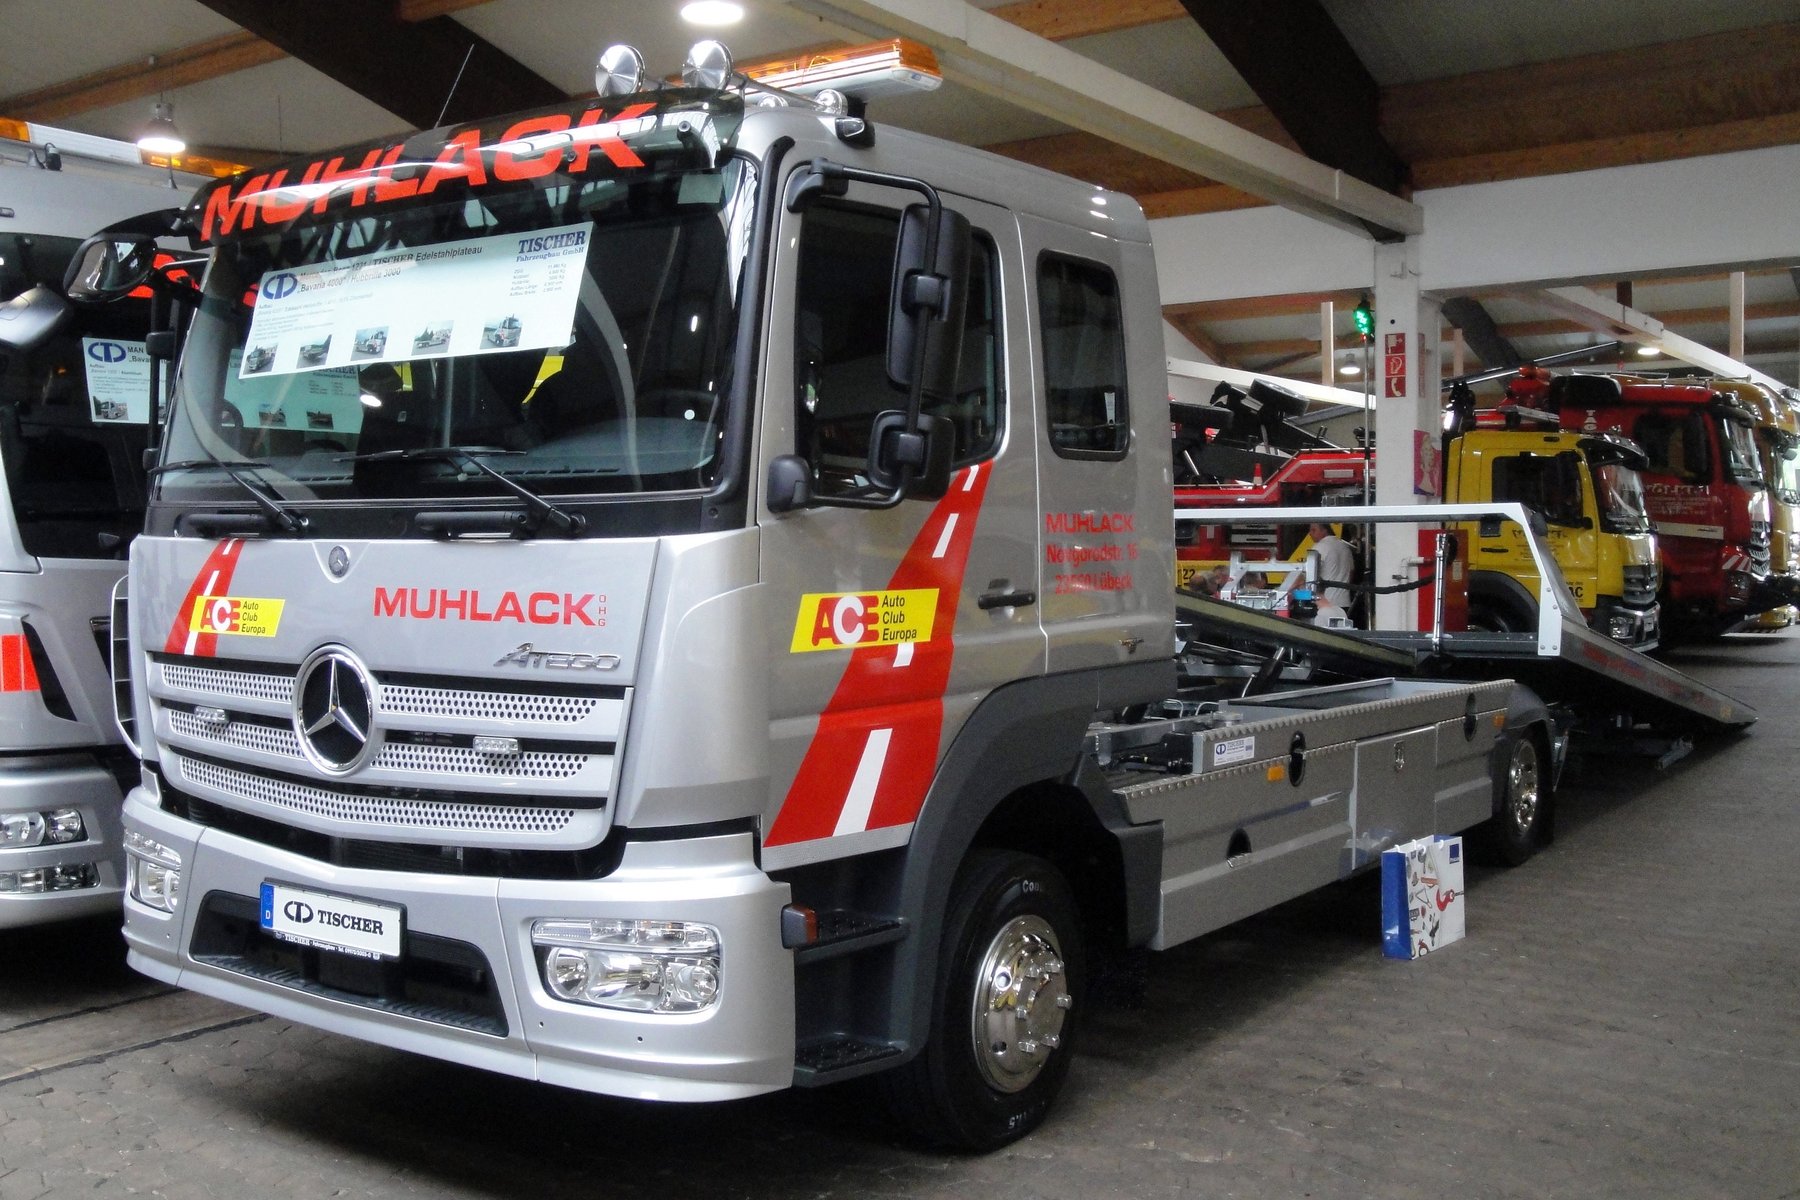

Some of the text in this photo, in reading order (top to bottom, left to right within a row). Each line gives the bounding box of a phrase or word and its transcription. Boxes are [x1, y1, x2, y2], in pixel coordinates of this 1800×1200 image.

[200, 103, 657, 241] MUHLACK
[518, 230, 586, 254] TISCHER
[415, 246, 483, 261] Edelstahlplateau
[1045, 511, 1136, 533] MUHLACK
[242, 601, 259, 610] Auto
[373, 587, 596, 626] MUHLACK
[882, 595, 905, 608] Auto
[200, 598, 241, 632] ACE
[242, 612, 258, 621] Club
[812, 595, 880, 646] ACE
[882, 612, 905, 624] Club
[241, 623, 266, 635] Europa
[882, 628, 917, 642] Europa
[265, 910, 271, 920] D
[318, 910, 383, 935] TISCHER
